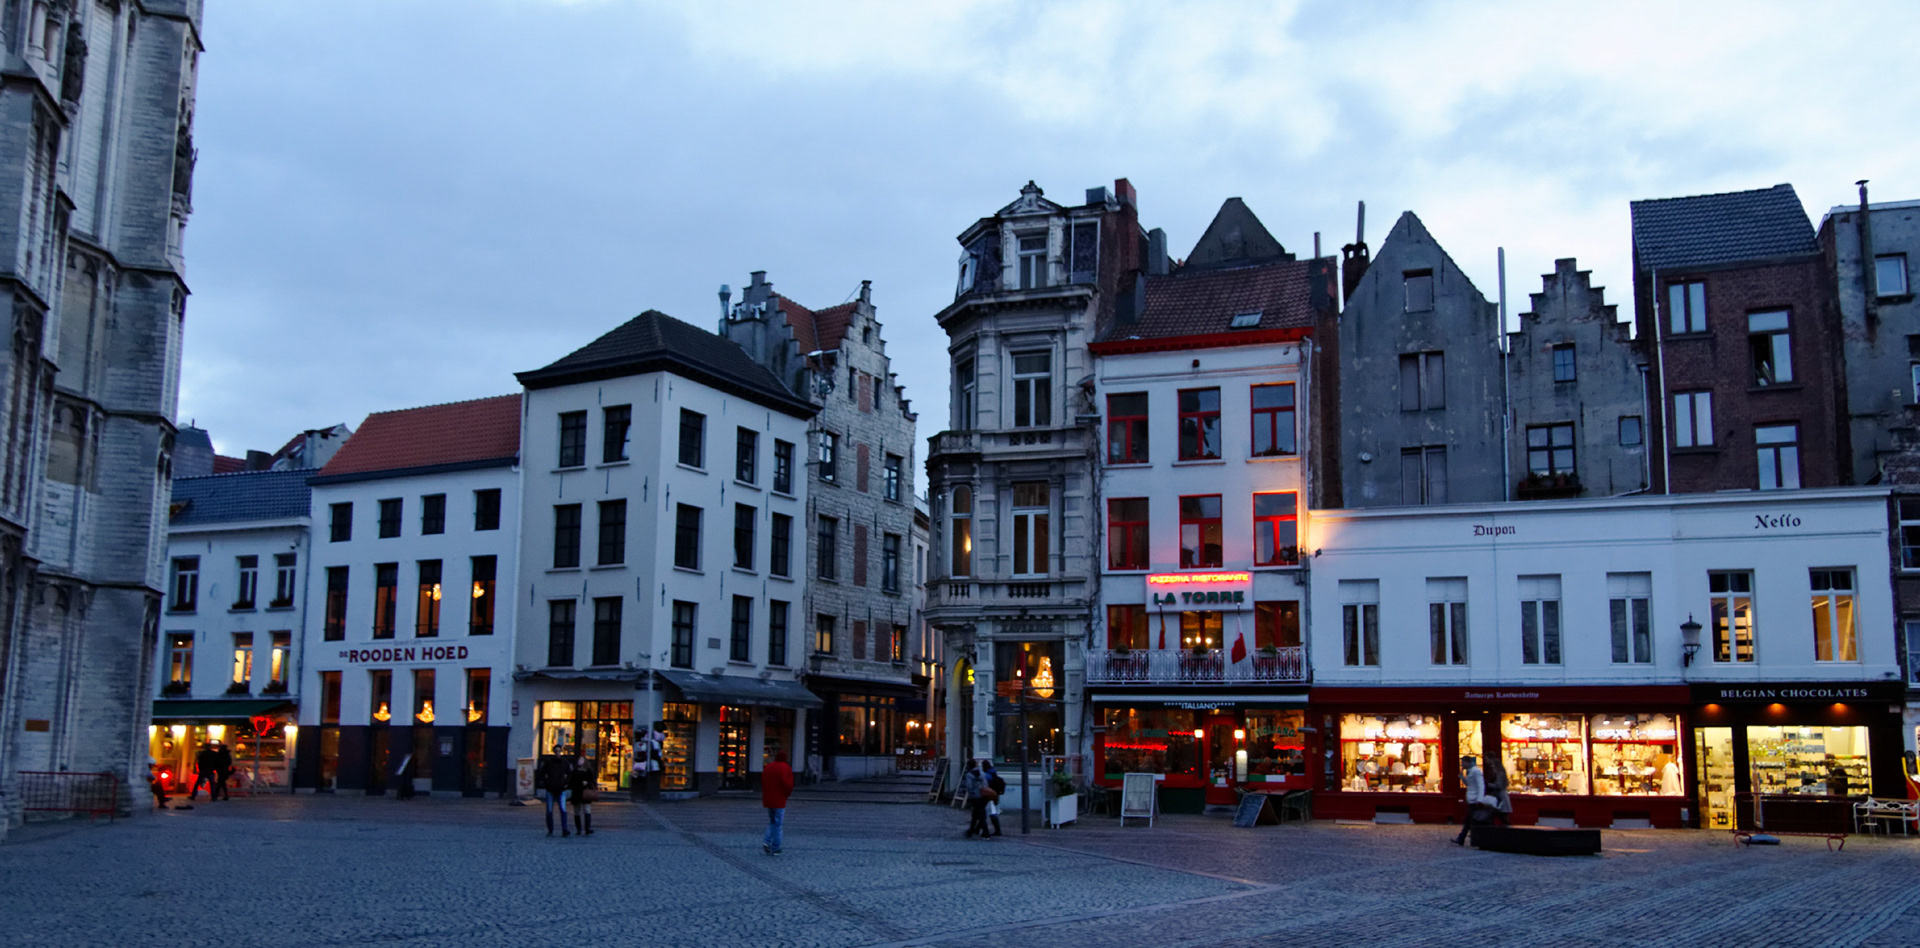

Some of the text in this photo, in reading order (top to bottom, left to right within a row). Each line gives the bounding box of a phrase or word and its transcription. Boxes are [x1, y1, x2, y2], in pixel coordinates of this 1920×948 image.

[1755, 513, 1801, 529] Nello
[1473, 525, 1516, 537] Dupon
[1150, 573, 1249, 584] PIZZERIA RISTORANTE
[1153, 591, 1244, 604] LA TORRE
[339, 645, 469, 663] DE ROODEN HOED
[1720, 688, 1868, 698] BELGIAN CHOCOLATES
